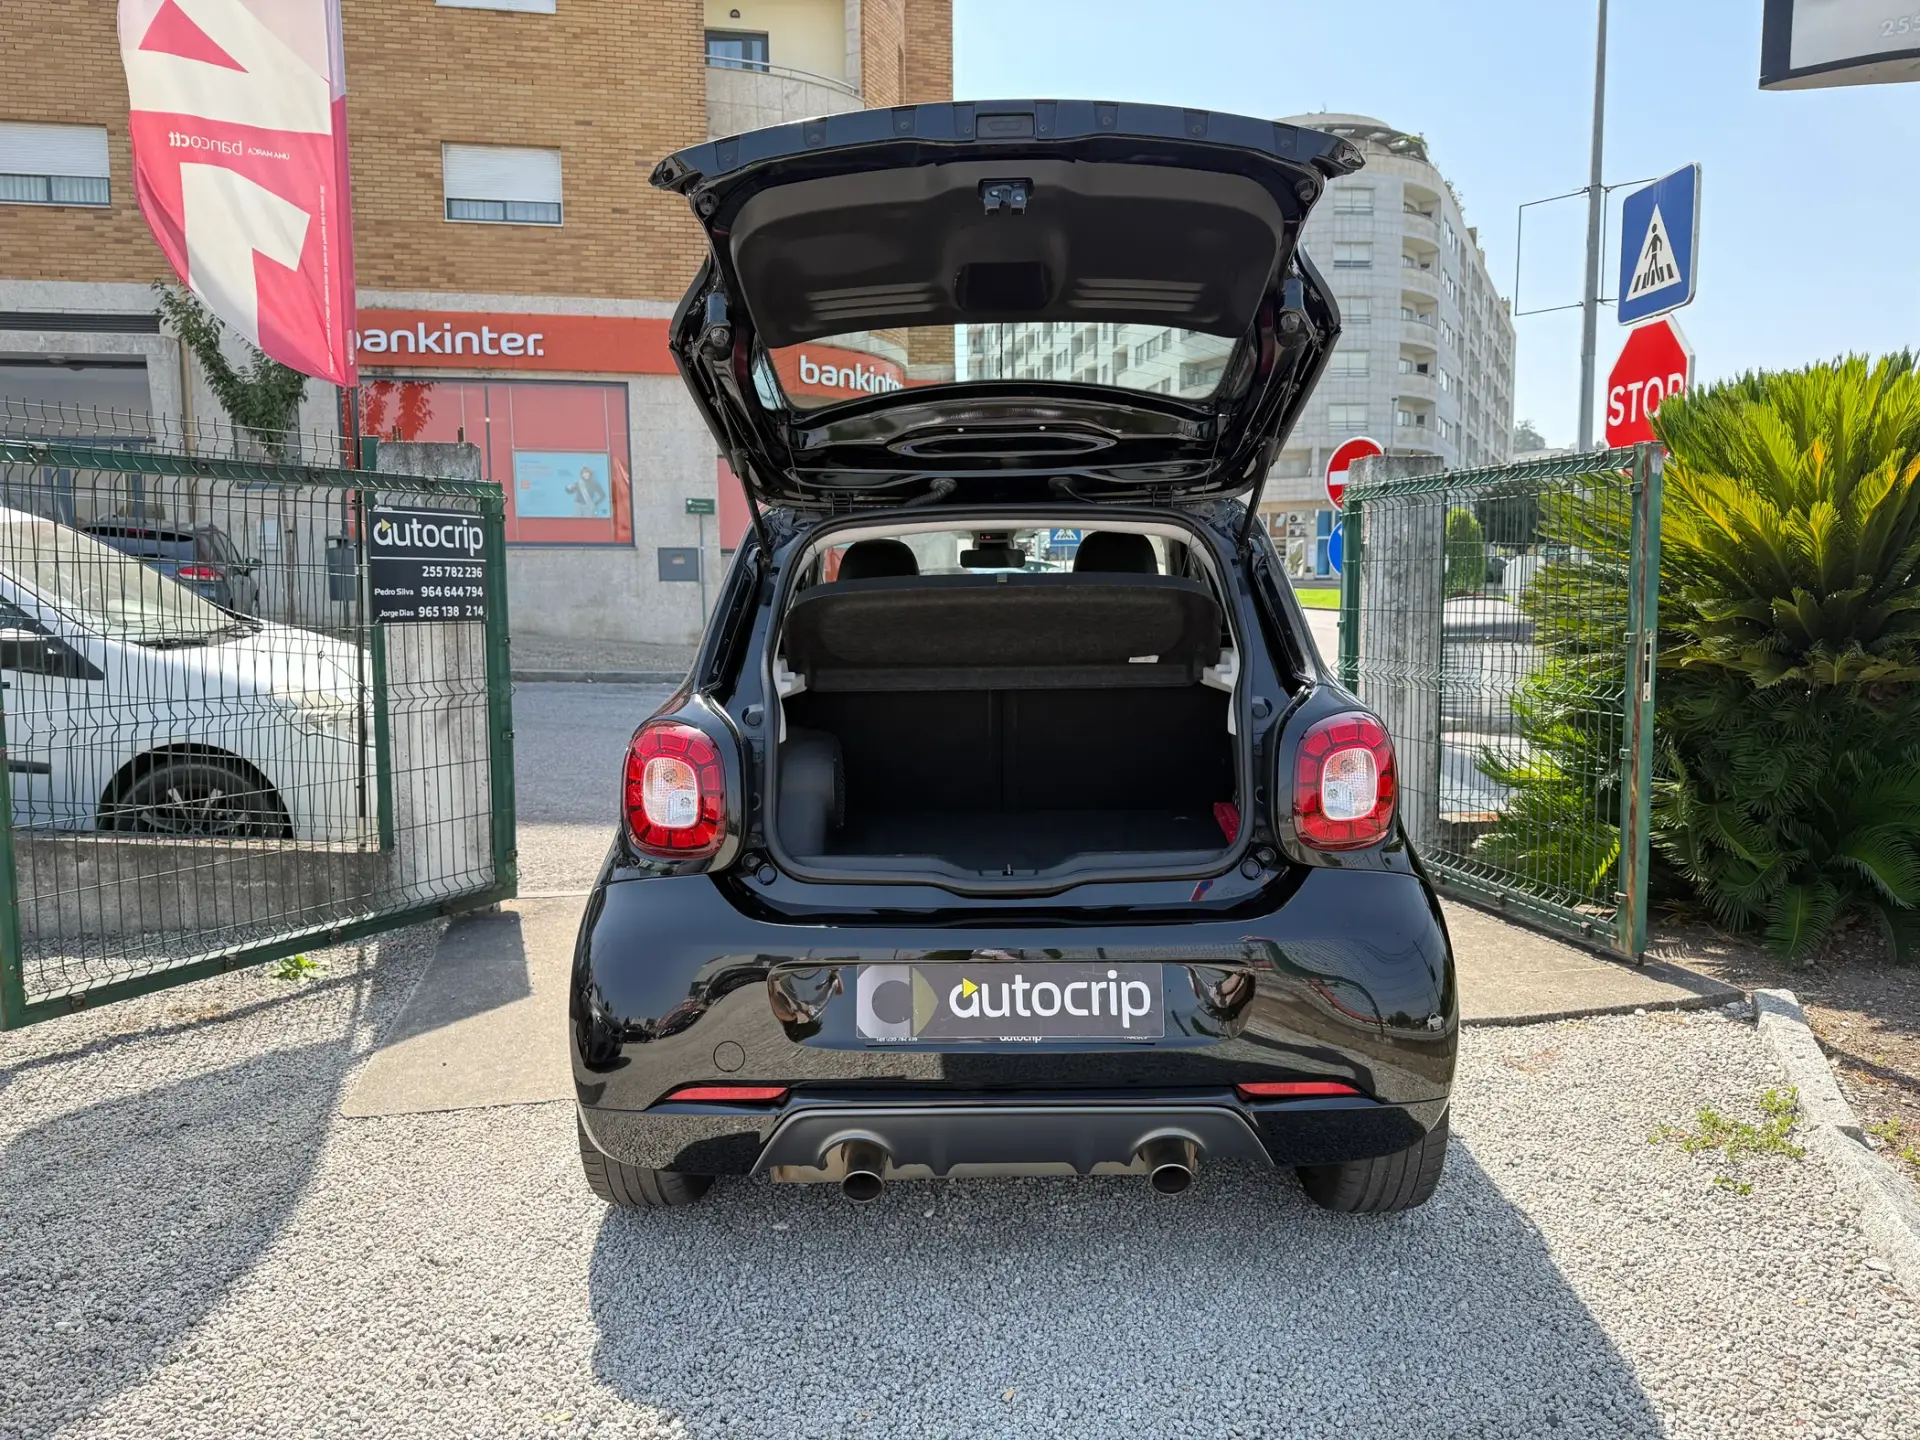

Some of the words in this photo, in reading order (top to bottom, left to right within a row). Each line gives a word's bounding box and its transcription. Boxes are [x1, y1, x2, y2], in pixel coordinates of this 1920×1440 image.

[356, 321, 544, 356] ankinter.
[373, 517, 484, 557] autocrip
[422, 565, 443, 578] 255
[444, 566, 464, 578] 782
[465, 566, 483, 578] 236
[374, 588, 396, 596] Pedro
[396, 588, 414, 596] Silva
[421, 586, 442, 598] 964
[444, 586, 464, 598] 644
[465, 586, 484, 597] 794
[379, 609, 399, 618] Jorge
[399, 609, 414, 617] Dias
[418, 606, 440, 618] 965
[441, 606, 460, 617] 138
[465, 605, 484, 617] 214
[949, 969, 1151, 1028] autocrip
